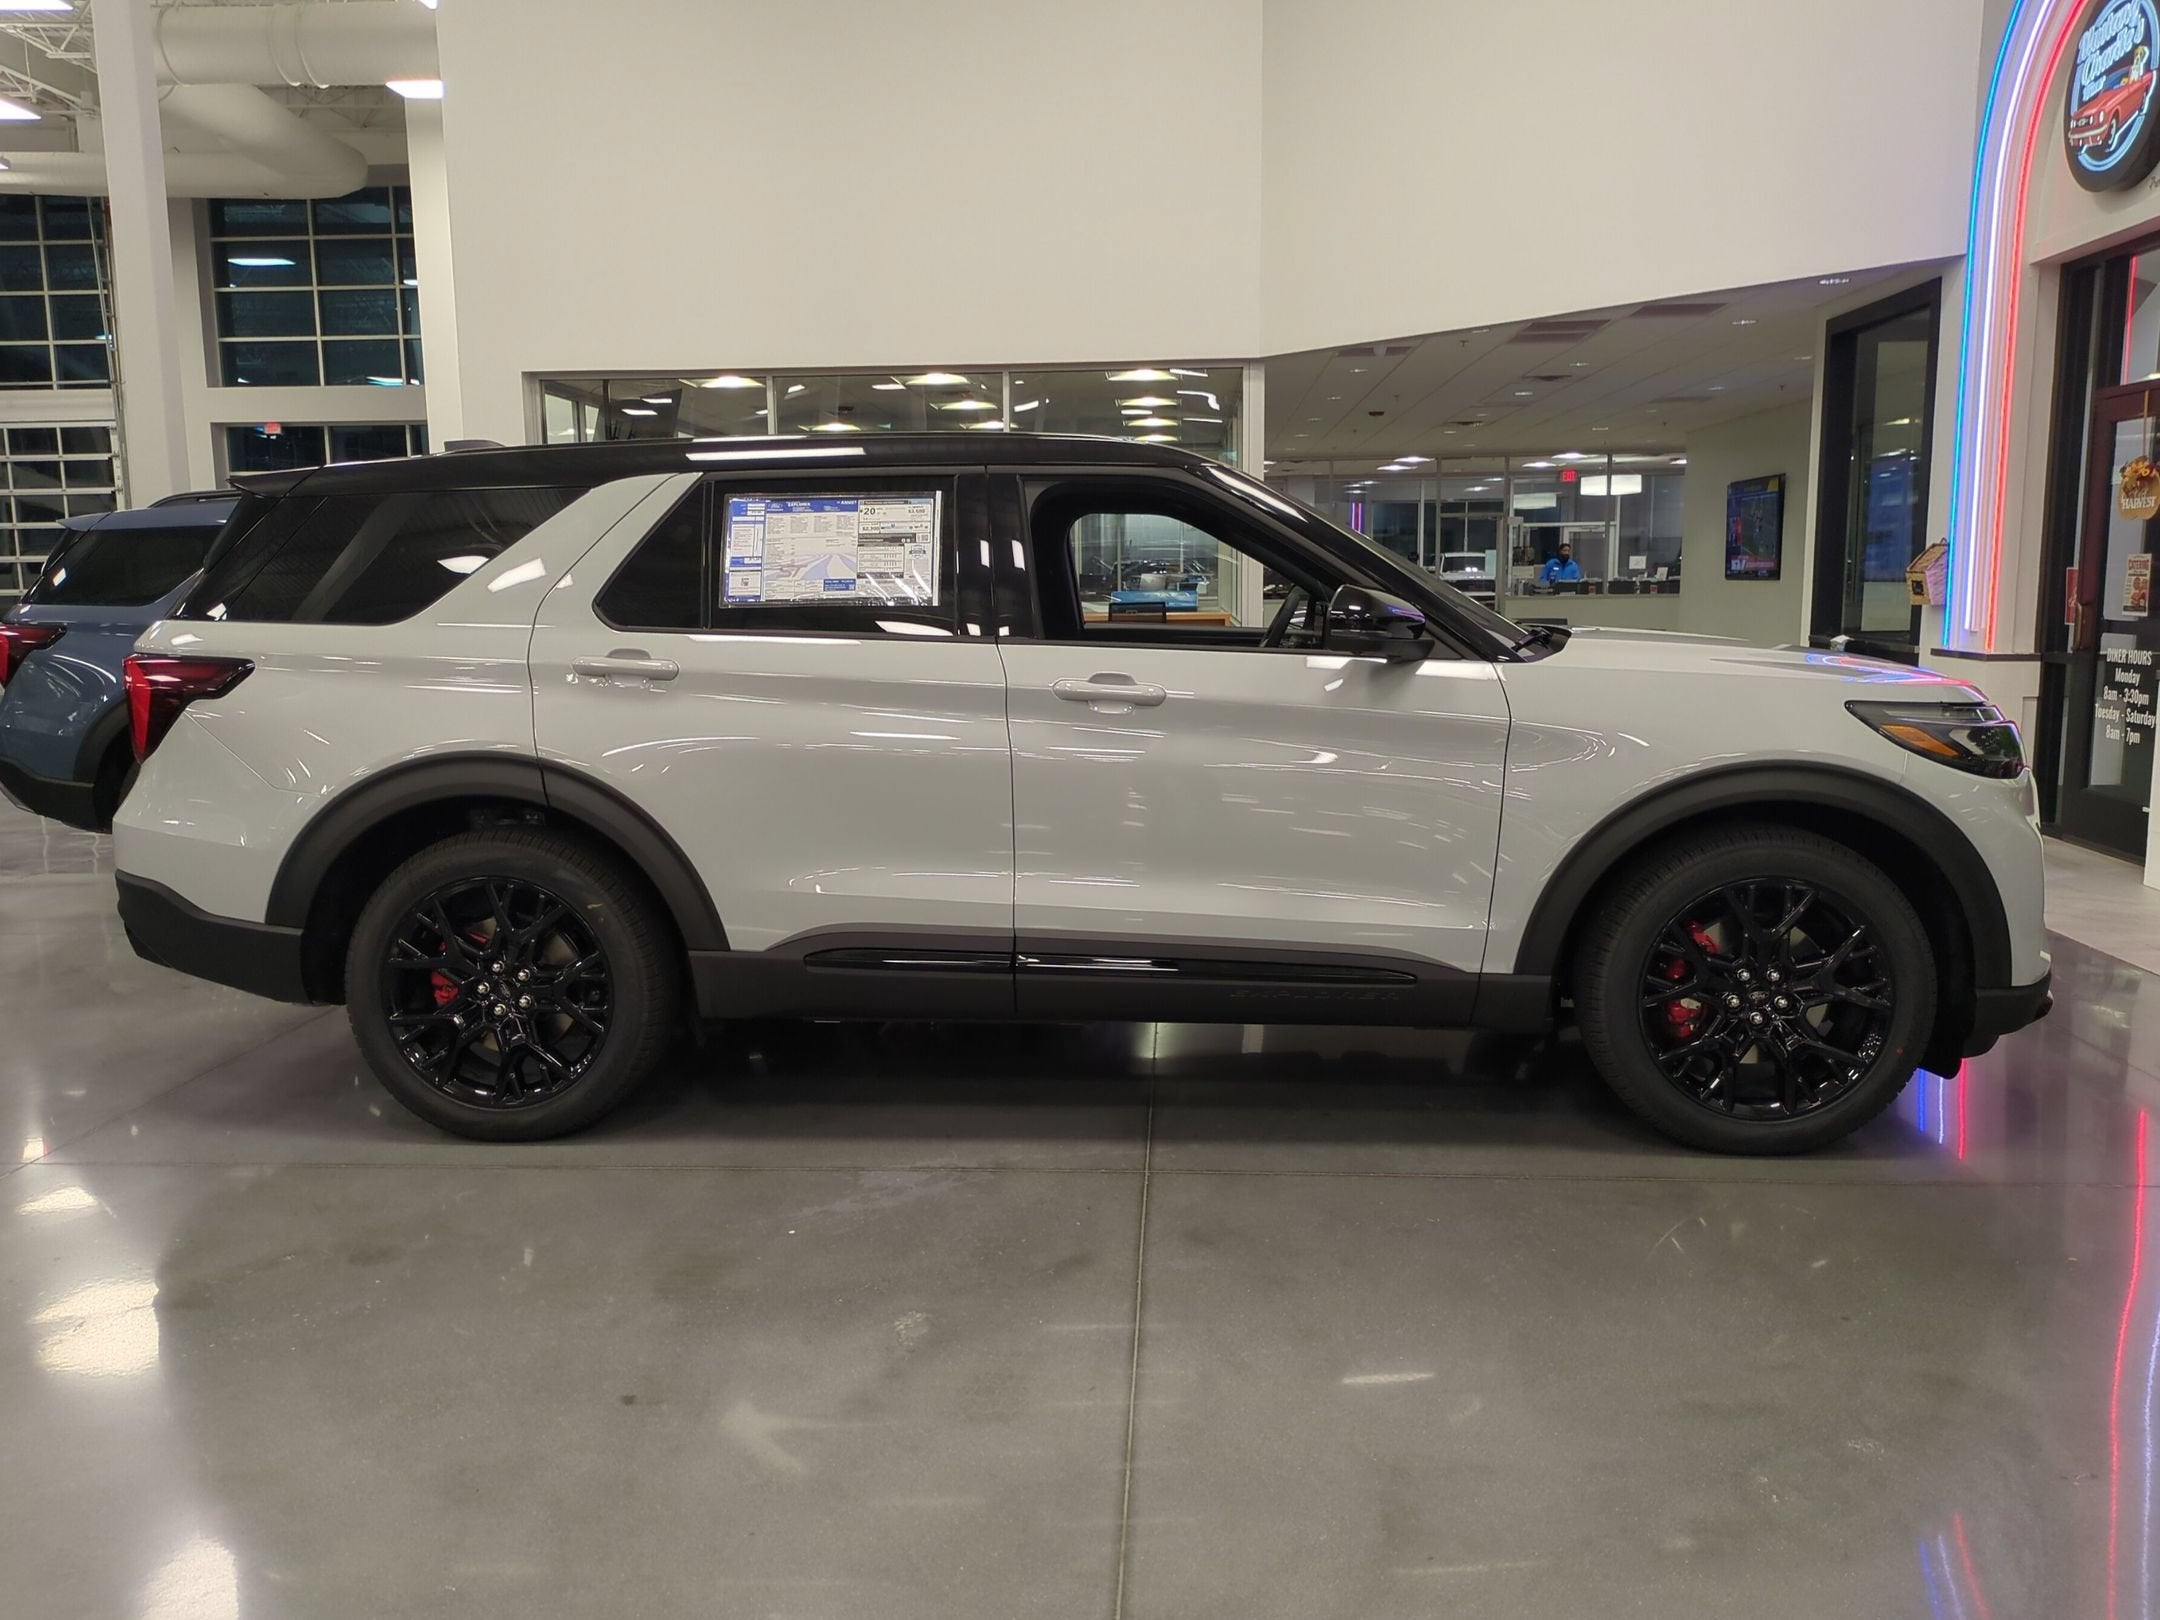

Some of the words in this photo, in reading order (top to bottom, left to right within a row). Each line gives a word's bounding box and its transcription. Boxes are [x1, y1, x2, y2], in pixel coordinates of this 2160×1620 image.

[863, 507, 876, 516] 20
[2106, 648, 2127, 664] DINER
[2127, 649, 2153, 666] HOURS
[2114, 668, 2141, 686] Monday
[2103, 685, 2118, 701] 8am
[2123, 688, 2150, 707] 3:30pm
[2095, 703, 2120, 723] Tuesday
[2126, 708, 2157, 728] Saturday
[2106, 724, 2120, 740] 8am
[2126, 727, 2141, 746] 7pm
